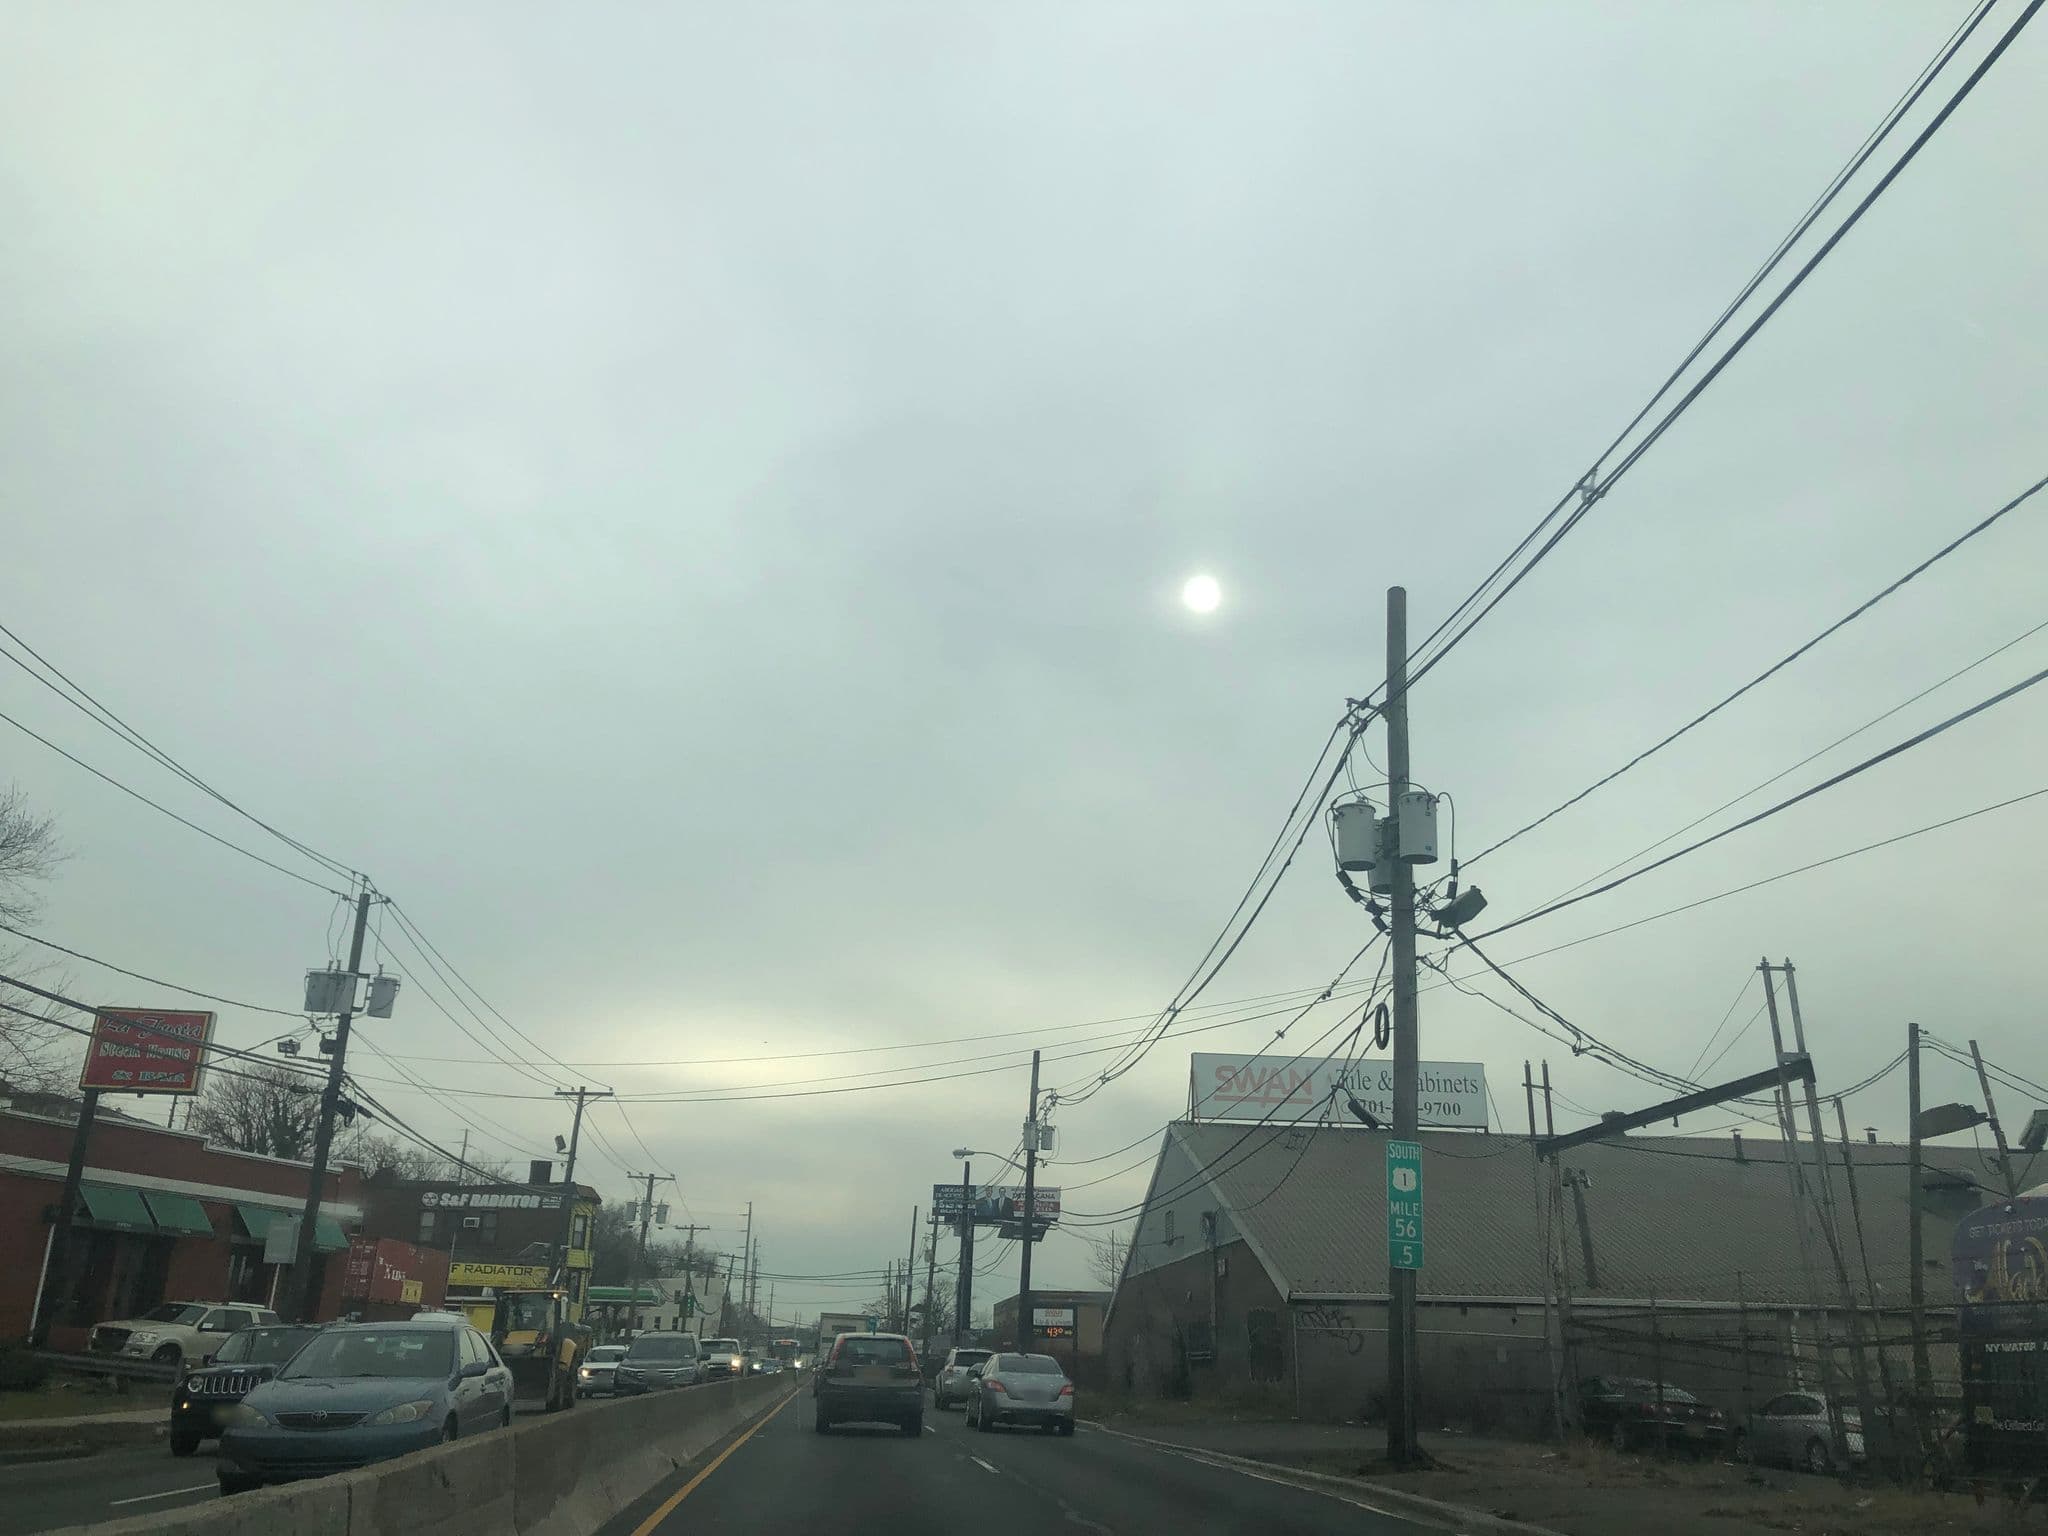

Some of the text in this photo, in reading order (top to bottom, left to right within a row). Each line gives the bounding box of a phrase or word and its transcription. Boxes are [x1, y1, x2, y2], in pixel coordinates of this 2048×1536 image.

[1215, 1065, 1313, 1095] SWAN
[1378, 1070, 1394, 1091] &
[1416, 1071, 1478, 1094] abinets
[1389, 1143, 1420, 1160] SOUTH
[469, 1193, 541, 1208] RADIATOR
[1390, 1201, 1420, 1217] MILE
[1395, 1218, 1416, 1238] 56
[464, 1265, 533, 1276] RADIATOR
